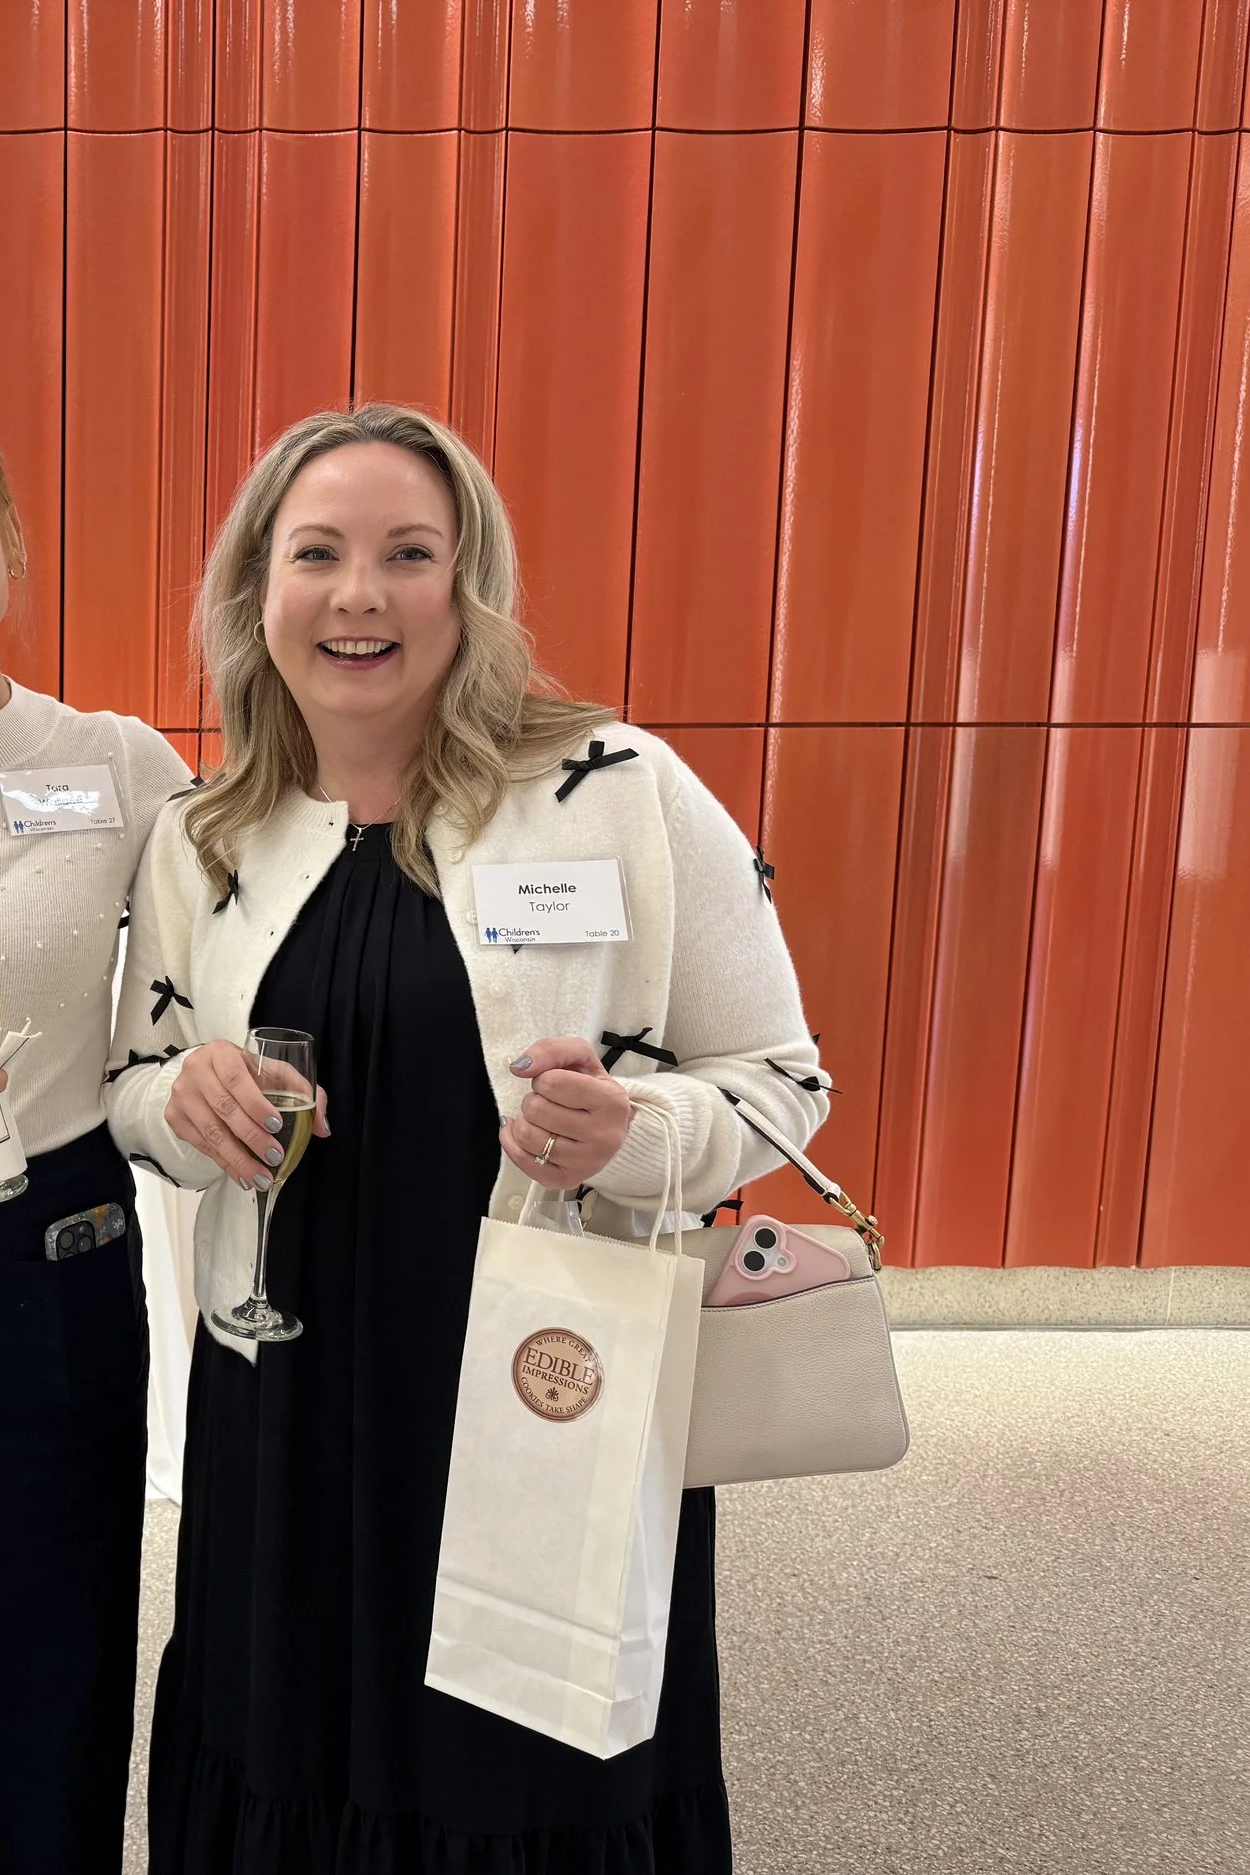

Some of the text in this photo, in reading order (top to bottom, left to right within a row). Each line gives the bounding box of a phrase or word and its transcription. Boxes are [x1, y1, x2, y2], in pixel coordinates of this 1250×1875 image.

[518, 883, 577, 895] Michelle
[529, 901, 570, 913] Taylor
[498, 928, 541, 937] Children's
[585, 929, 620, 938] Table 20
[536, 1336, 591, 1362] WHERE GREAT
[523, 1347, 595, 1386] EDIBLE
[522, 1365, 590, 1395] IMPRESSIONS
[521, 1376, 587, 1414] COOKIES TAKE SHAPE
